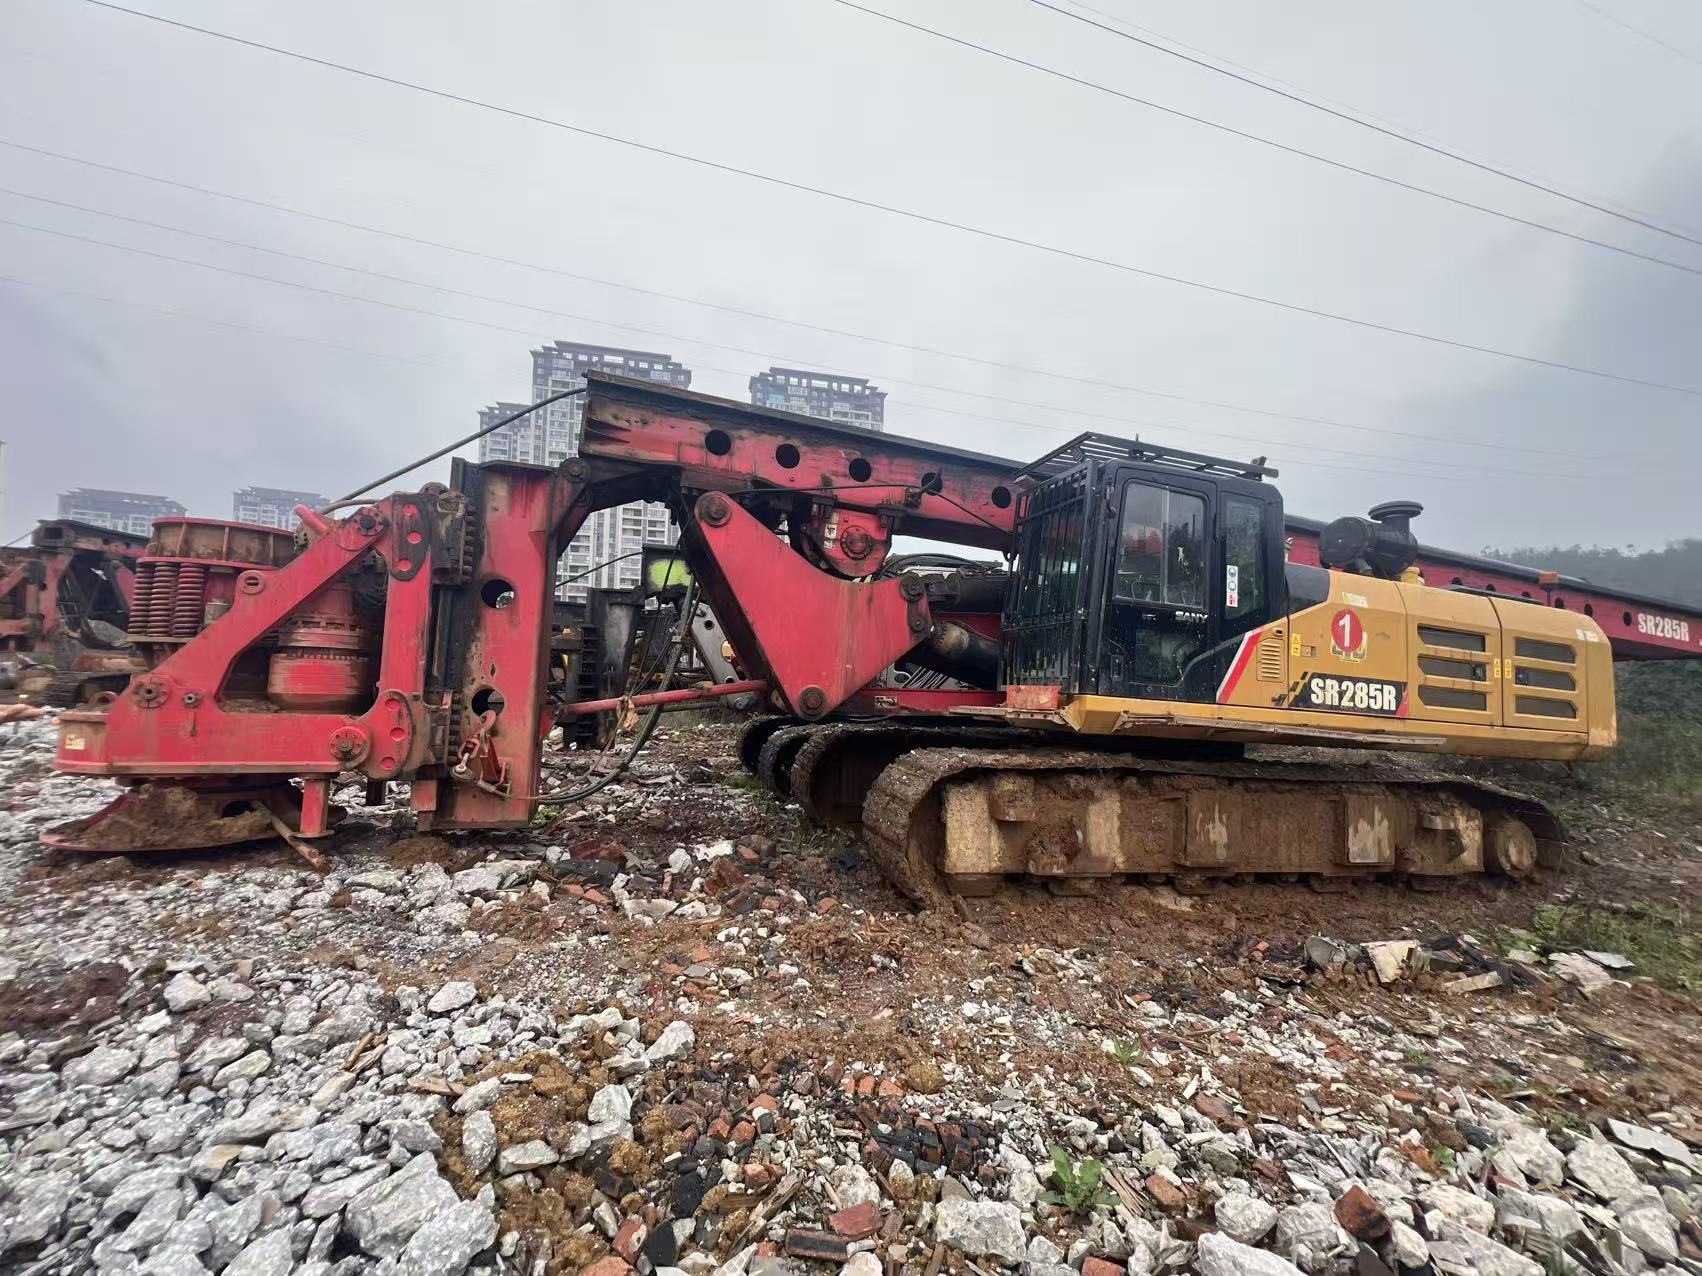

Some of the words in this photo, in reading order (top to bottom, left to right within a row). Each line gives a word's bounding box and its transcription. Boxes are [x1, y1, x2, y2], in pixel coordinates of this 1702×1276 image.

[1339, 613, 1350, 648] 1
[1638, 612, 1690, 642] SR285R
[1310, 678, 1397, 711] SR285R
